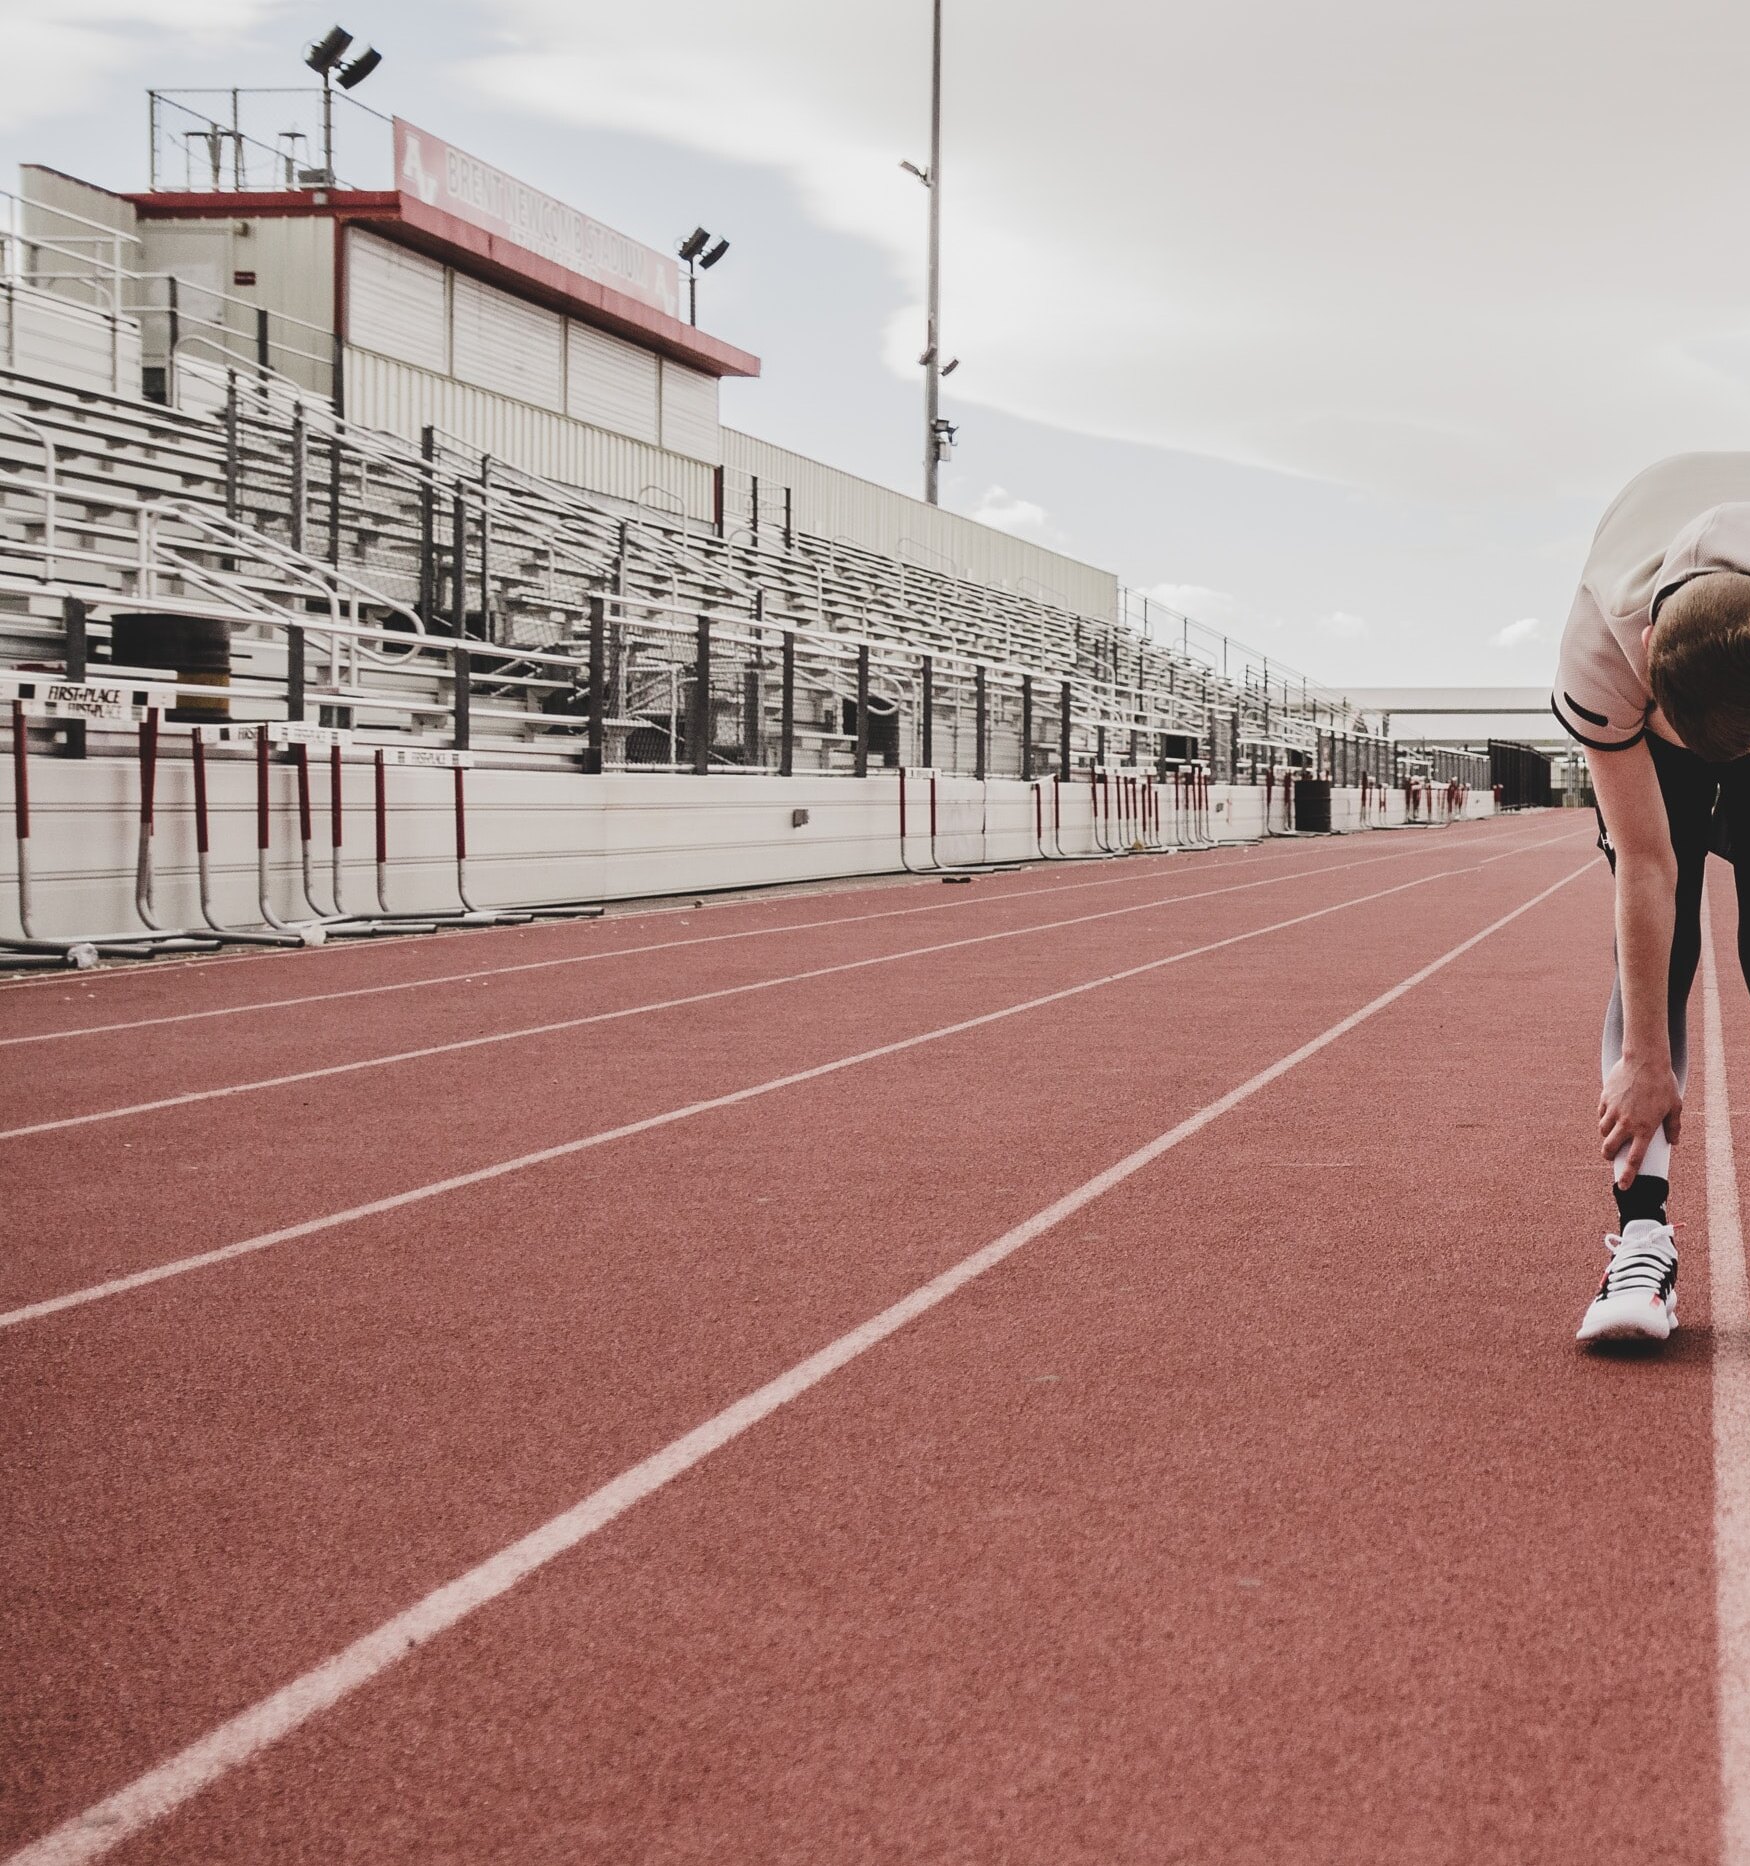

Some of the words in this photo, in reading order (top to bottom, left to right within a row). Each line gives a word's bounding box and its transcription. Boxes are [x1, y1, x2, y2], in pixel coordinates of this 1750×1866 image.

[446, 147, 503, 221] BRENT
[504, 178, 584, 255] NEWCOMB
[585, 219, 649, 289] STADIUM
